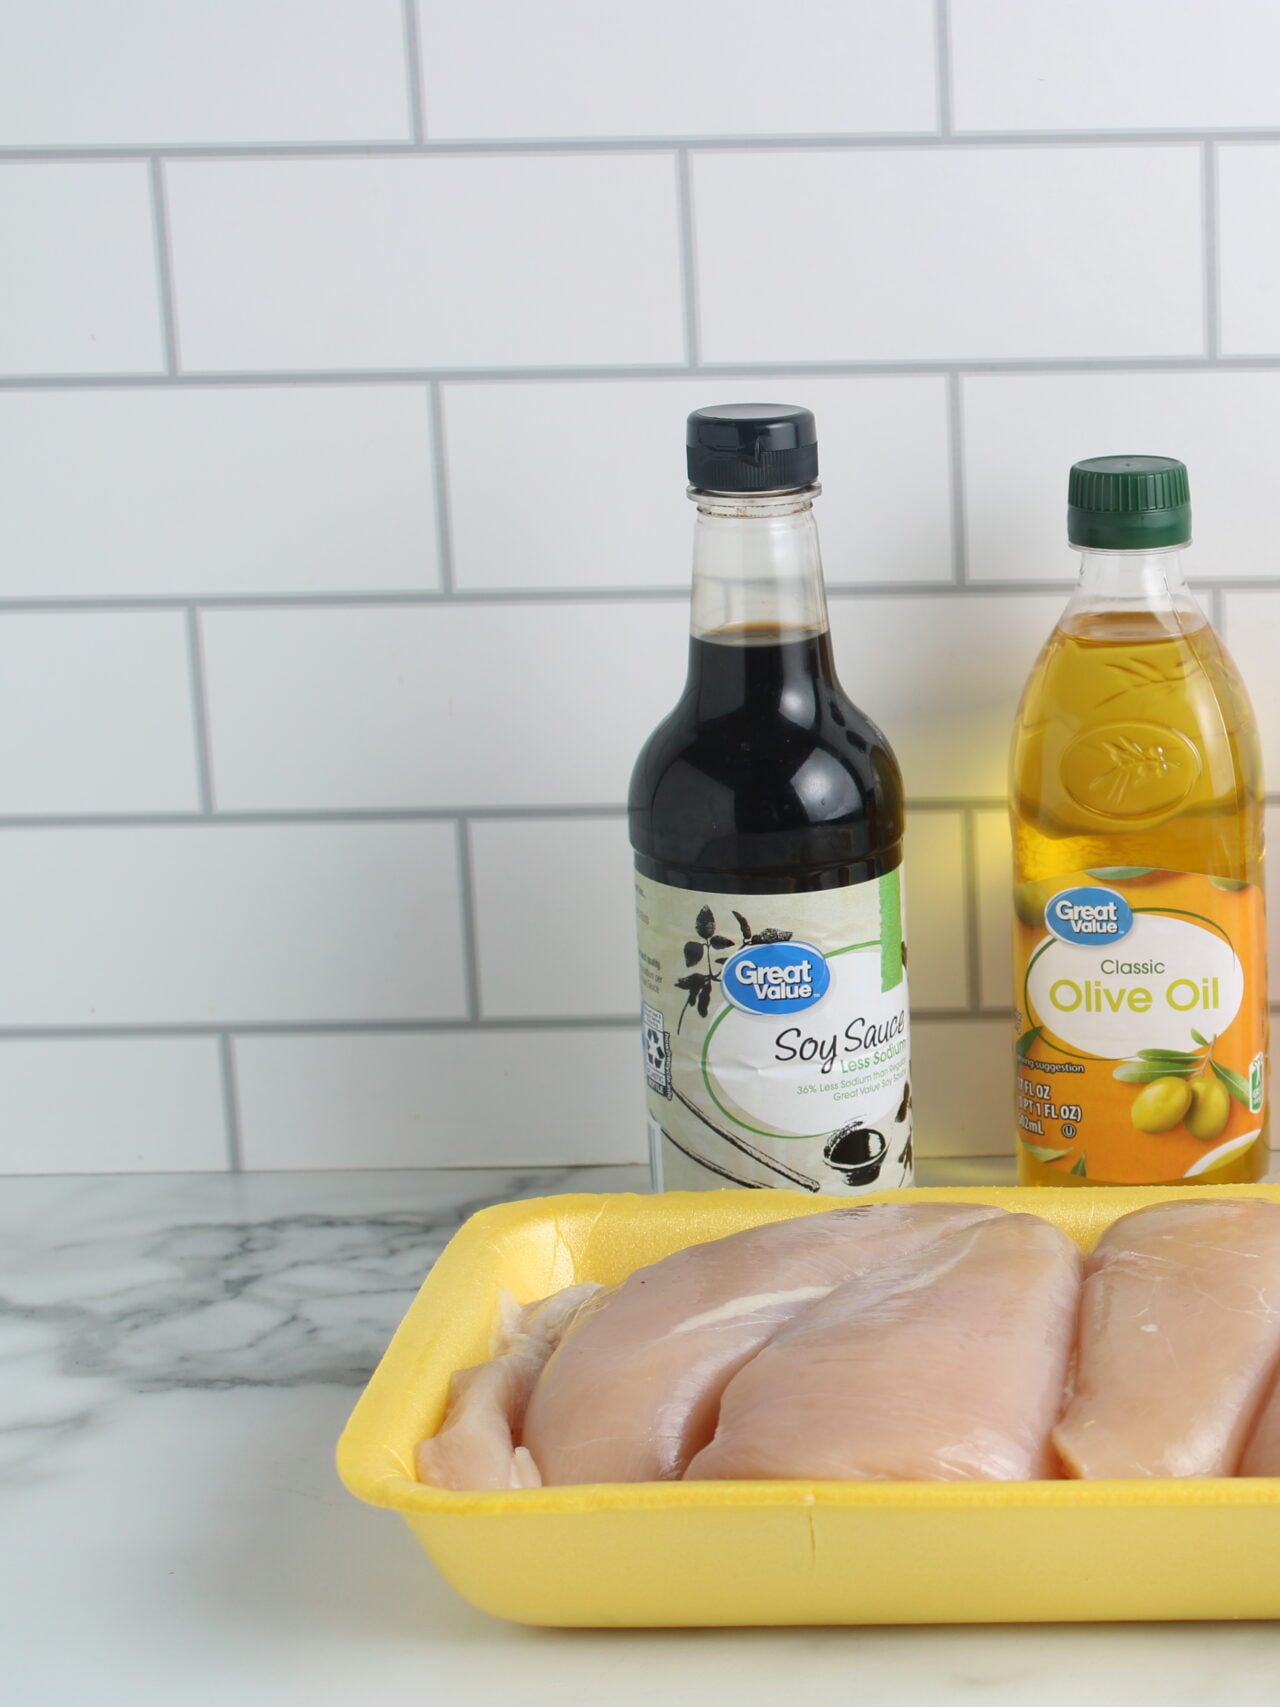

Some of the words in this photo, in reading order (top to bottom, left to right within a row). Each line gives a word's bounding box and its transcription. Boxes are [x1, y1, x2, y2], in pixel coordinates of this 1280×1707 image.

[1055, 900, 1119, 922] Great
[1069, 918, 1118, 934] Value
[735, 960, 812, 985] Great
[1100, 959, 1166, 975] Classic
[753, 982, 813, 1000] Value
[1049, 979, 1153, 1013] Olive
[1165, 977, 1220, 1011] Oil
[774, 1027, 838, 1074] Soy
[844, 1009, 905, 1052] Sauce
[840, 1057, 870, 1074] Less
[873, 1039, 907, 1066] Sodium
[1035, 1062, 1084, 1073] suggestion
[796, 1084, 817, 1096] 36%
[819, 1082, 839, 1093] Less
[840, 1074, 872, 1089] Sodium
[873, 1068, 888, 1080] than
[833, 1088, 858, 1102] Great
[859, 1083, 881, 1095] Value
[881, 1078, 892, 1089] Soy
[1024, 1080, 1035, 1096] FL
[1036, 1084, 1051, 1100] OZ
[1023, 1098, 1034, 1114] PT
[1036, 1103, 1041, 1116] 1
[1044, 1104, 1058, 1119] FL
[1060, 1105, 1082, 1122] OZ)
